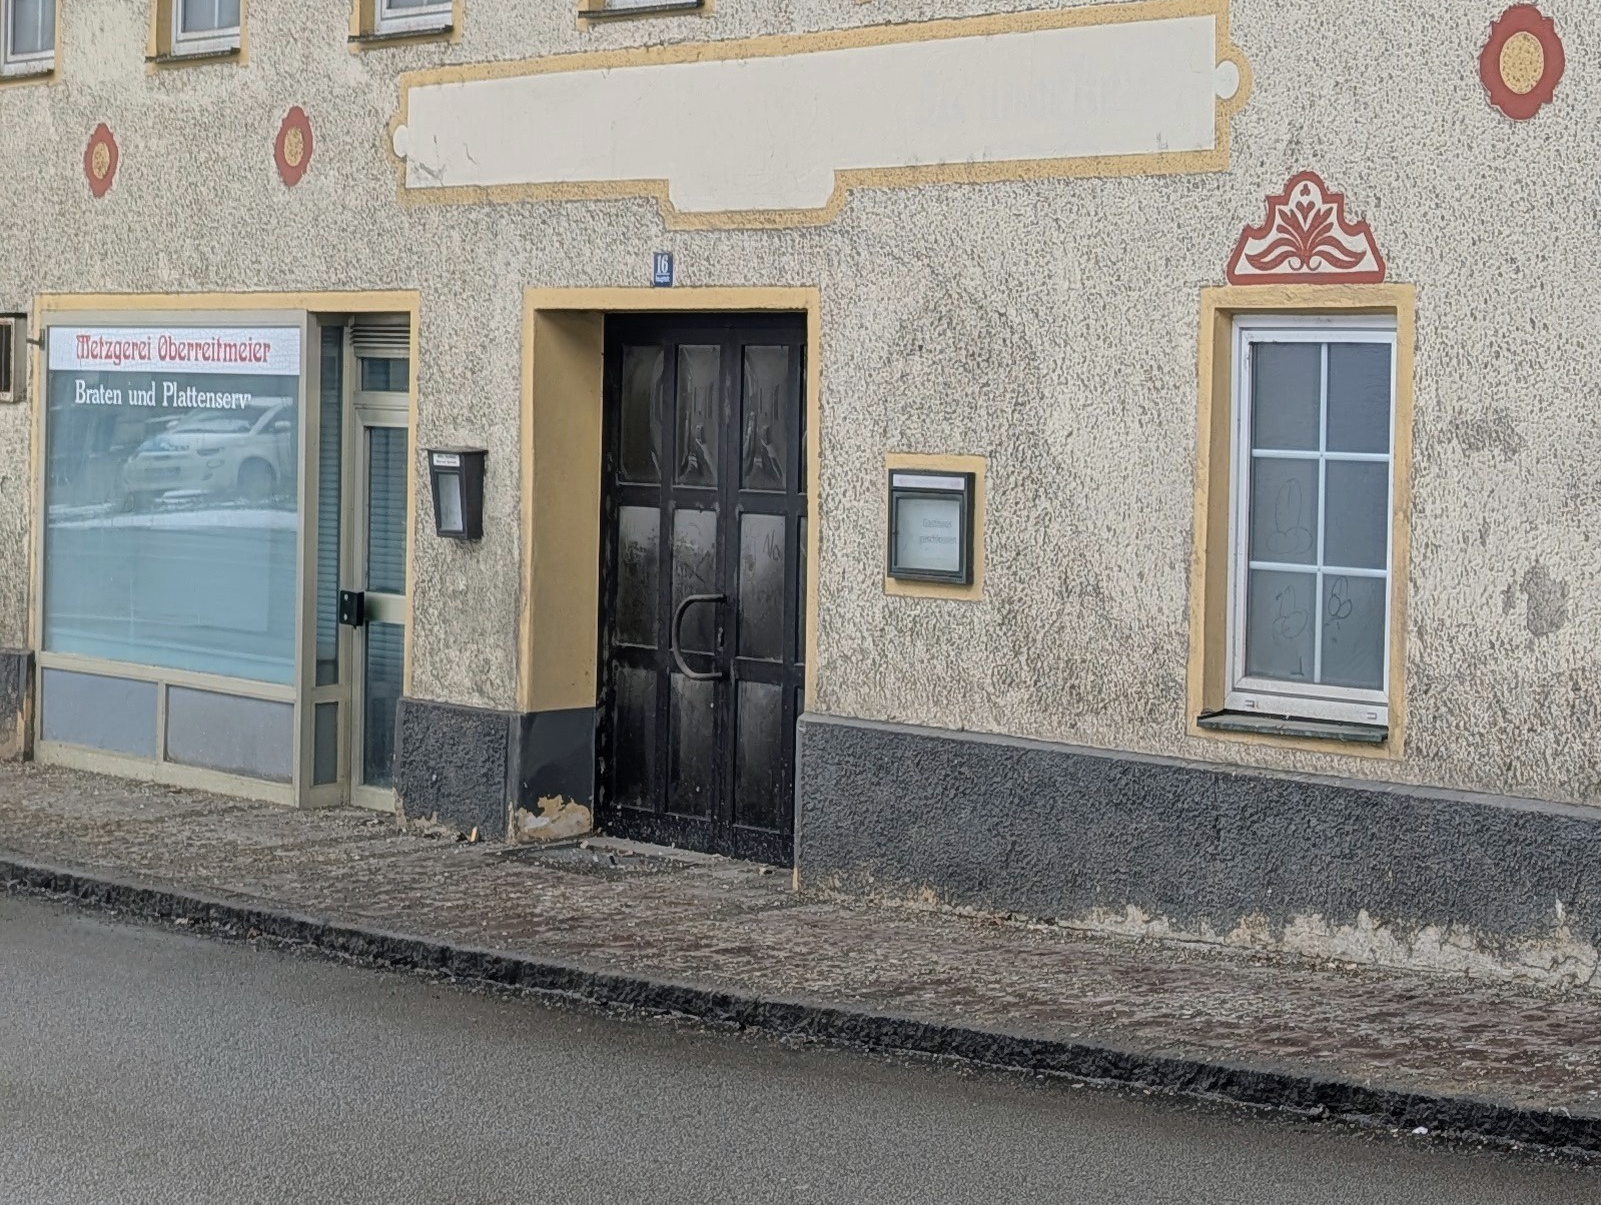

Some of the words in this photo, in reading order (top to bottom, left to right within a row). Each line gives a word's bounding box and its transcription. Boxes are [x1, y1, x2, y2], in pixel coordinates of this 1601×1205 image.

[657, 254, 669, 273] 16
[76, 334, 151, 366] Metzgerei
[157, 334, 271, 363] Oberreitmeier
[75, 379, 122, 405] Braten
[128, 381, 156, 407] und
[162, 381, 252, 410] Plattenserv
